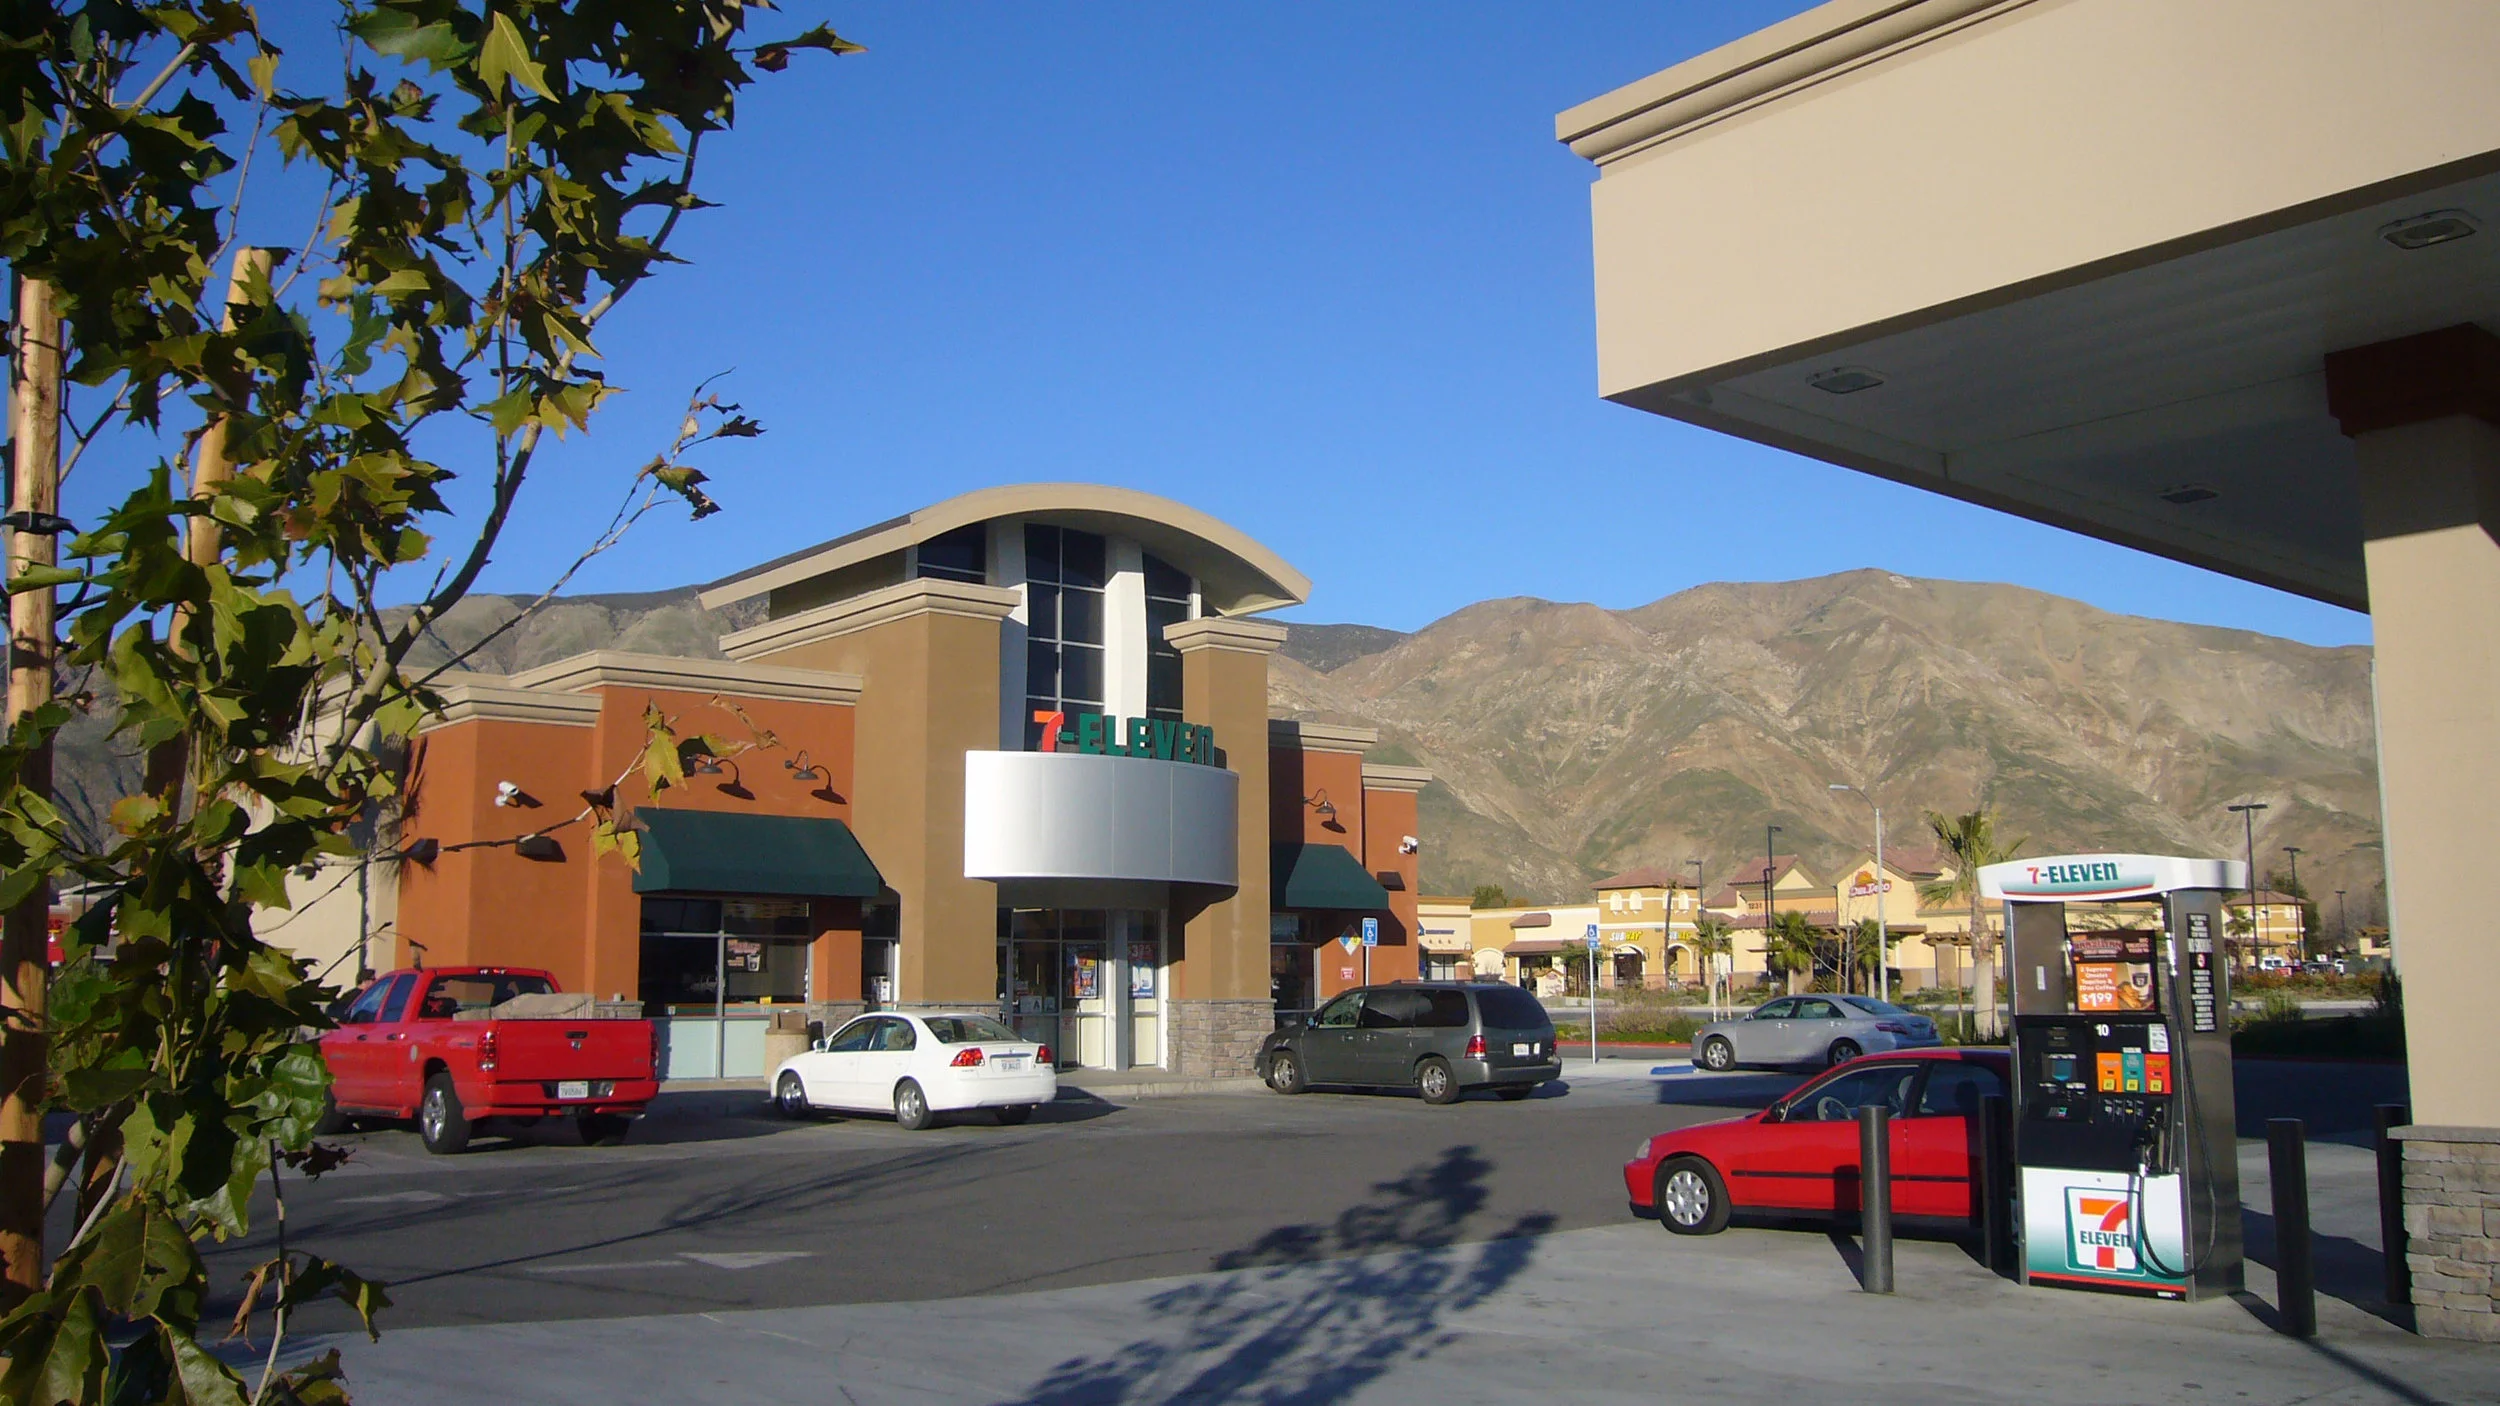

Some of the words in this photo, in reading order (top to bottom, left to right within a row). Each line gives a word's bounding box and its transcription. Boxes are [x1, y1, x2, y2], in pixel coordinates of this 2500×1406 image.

[1033, 710, 1215, 766] 7-ELEVEN
[2026, 862, 2119, 884] 7-ELEVEN
[1610, 931, 1643, 942] SUBWAY
[2095, 1024, 2109, 1036] 10
[2080, 1230, 2131, 1248] ELEVEN
